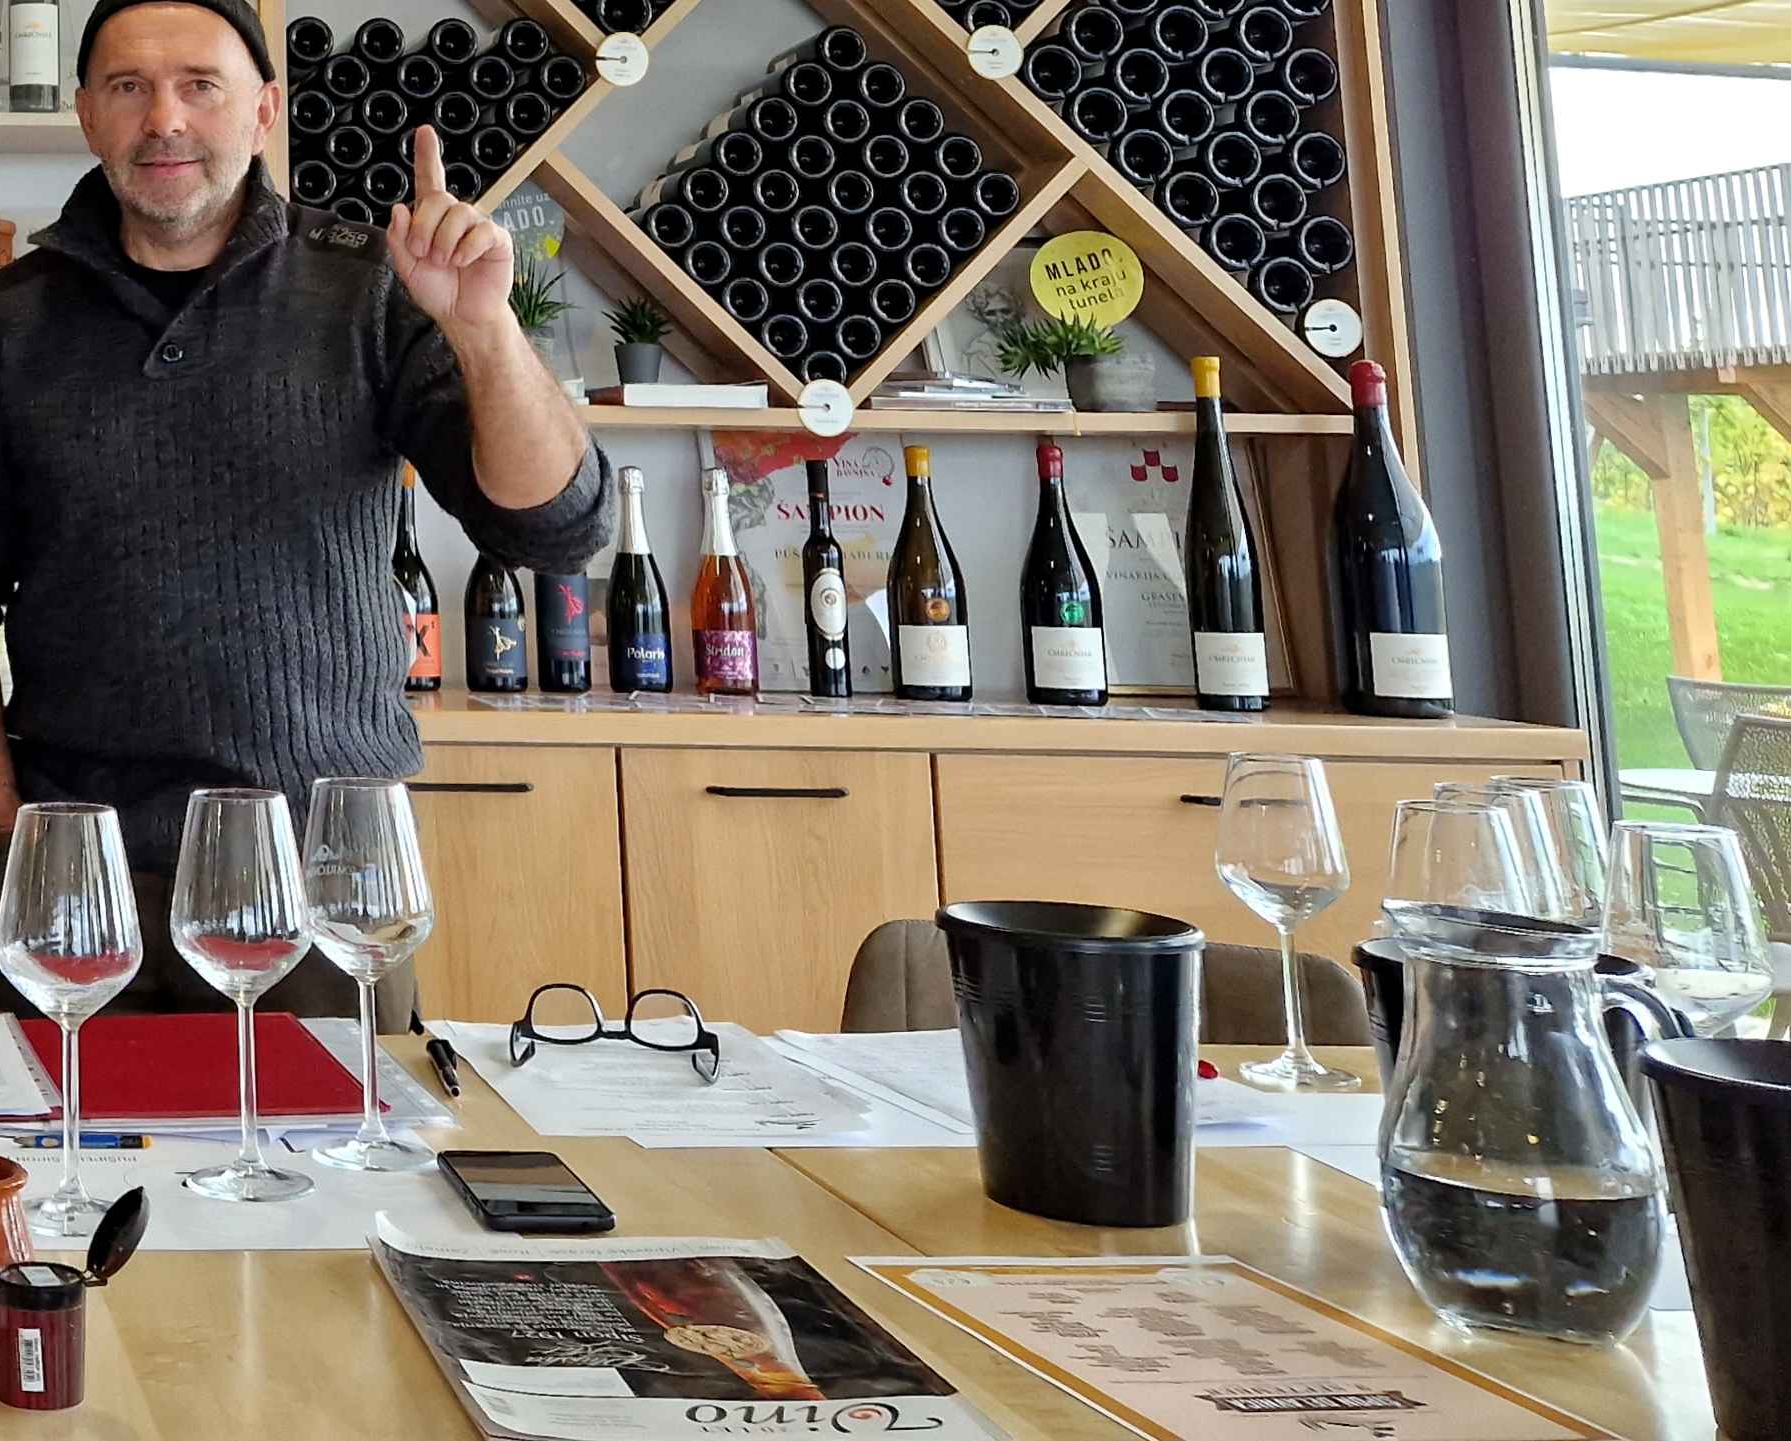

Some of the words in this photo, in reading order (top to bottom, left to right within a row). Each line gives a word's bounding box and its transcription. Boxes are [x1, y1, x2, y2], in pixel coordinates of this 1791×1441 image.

[1055, 284, 1077, 297] na
[776, 498, 885, 522] ŠAPION
[626, 647, 666, 660] Polaris
